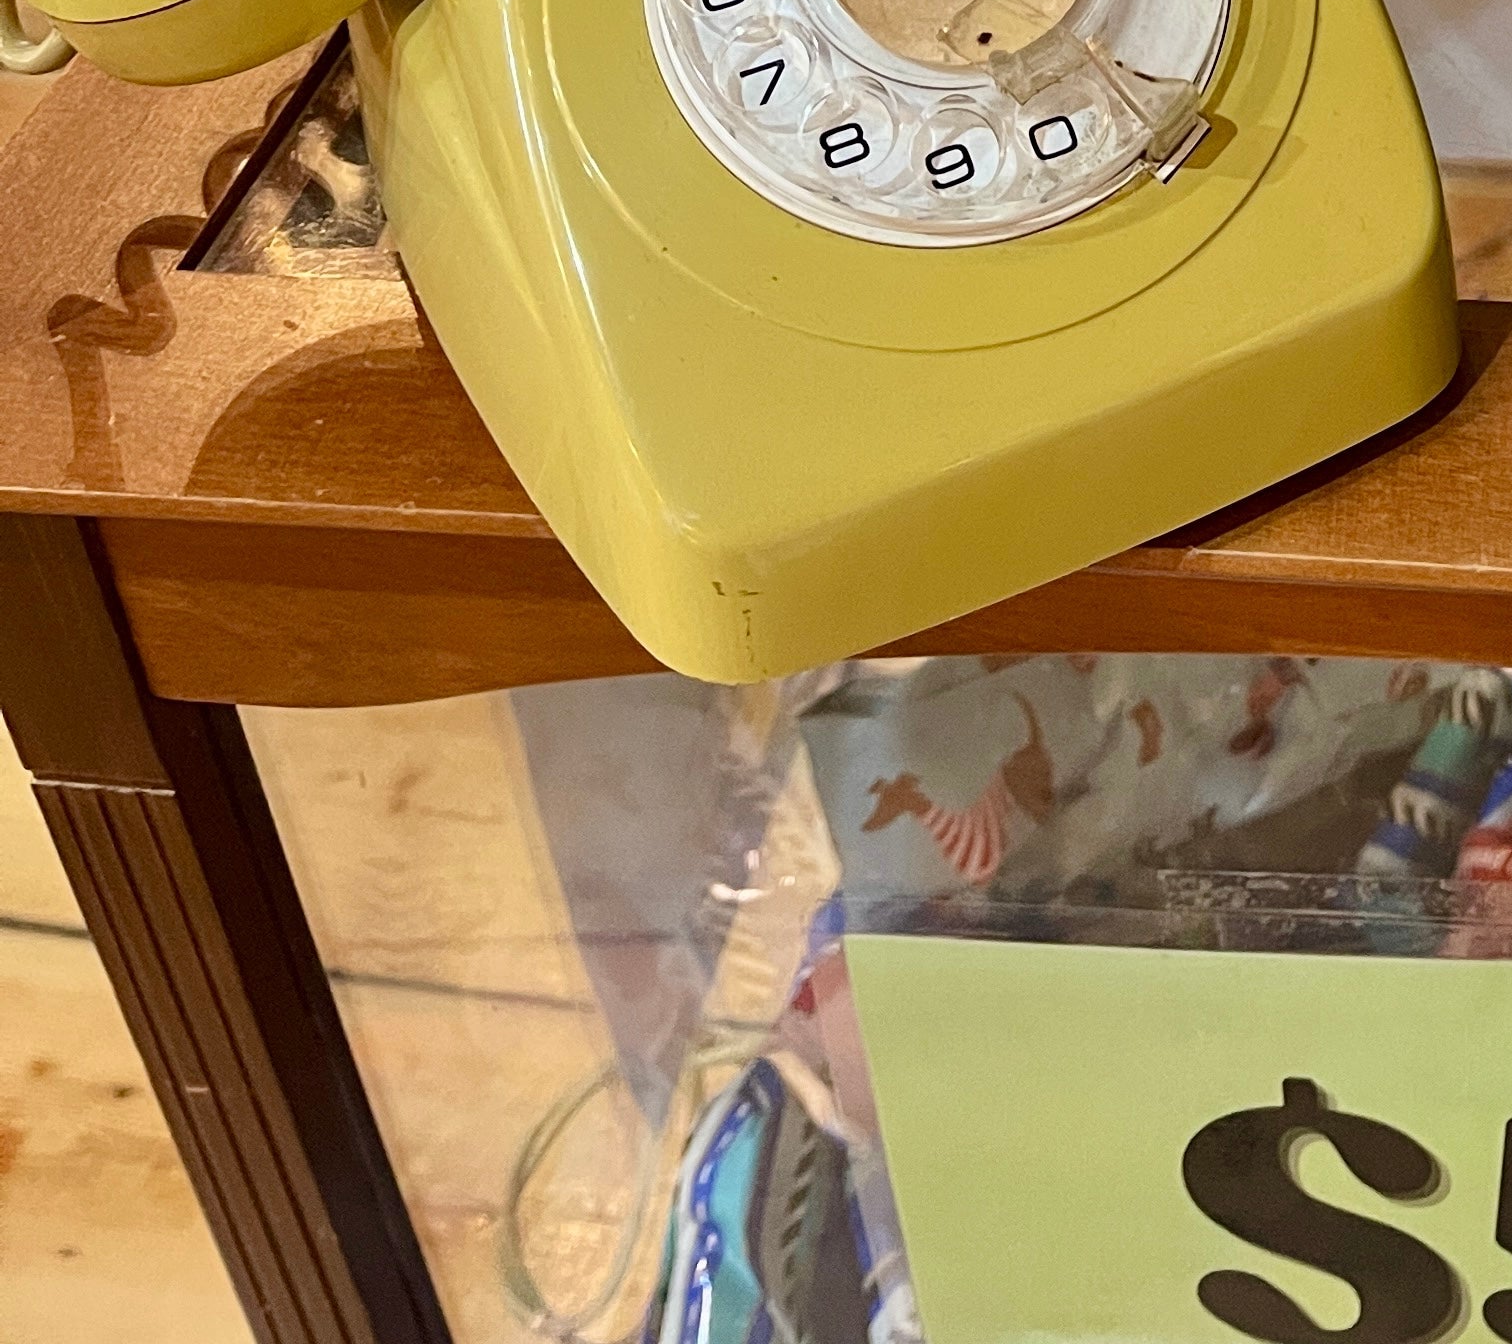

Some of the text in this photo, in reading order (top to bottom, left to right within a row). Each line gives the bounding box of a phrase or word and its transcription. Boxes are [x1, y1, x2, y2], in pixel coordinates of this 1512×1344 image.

[740, 59, 786, 107] 7
[819, 122, 871, 169] 8
[1028, 114, 1078, 161] 0
[925, 142, 975, 190] 9
